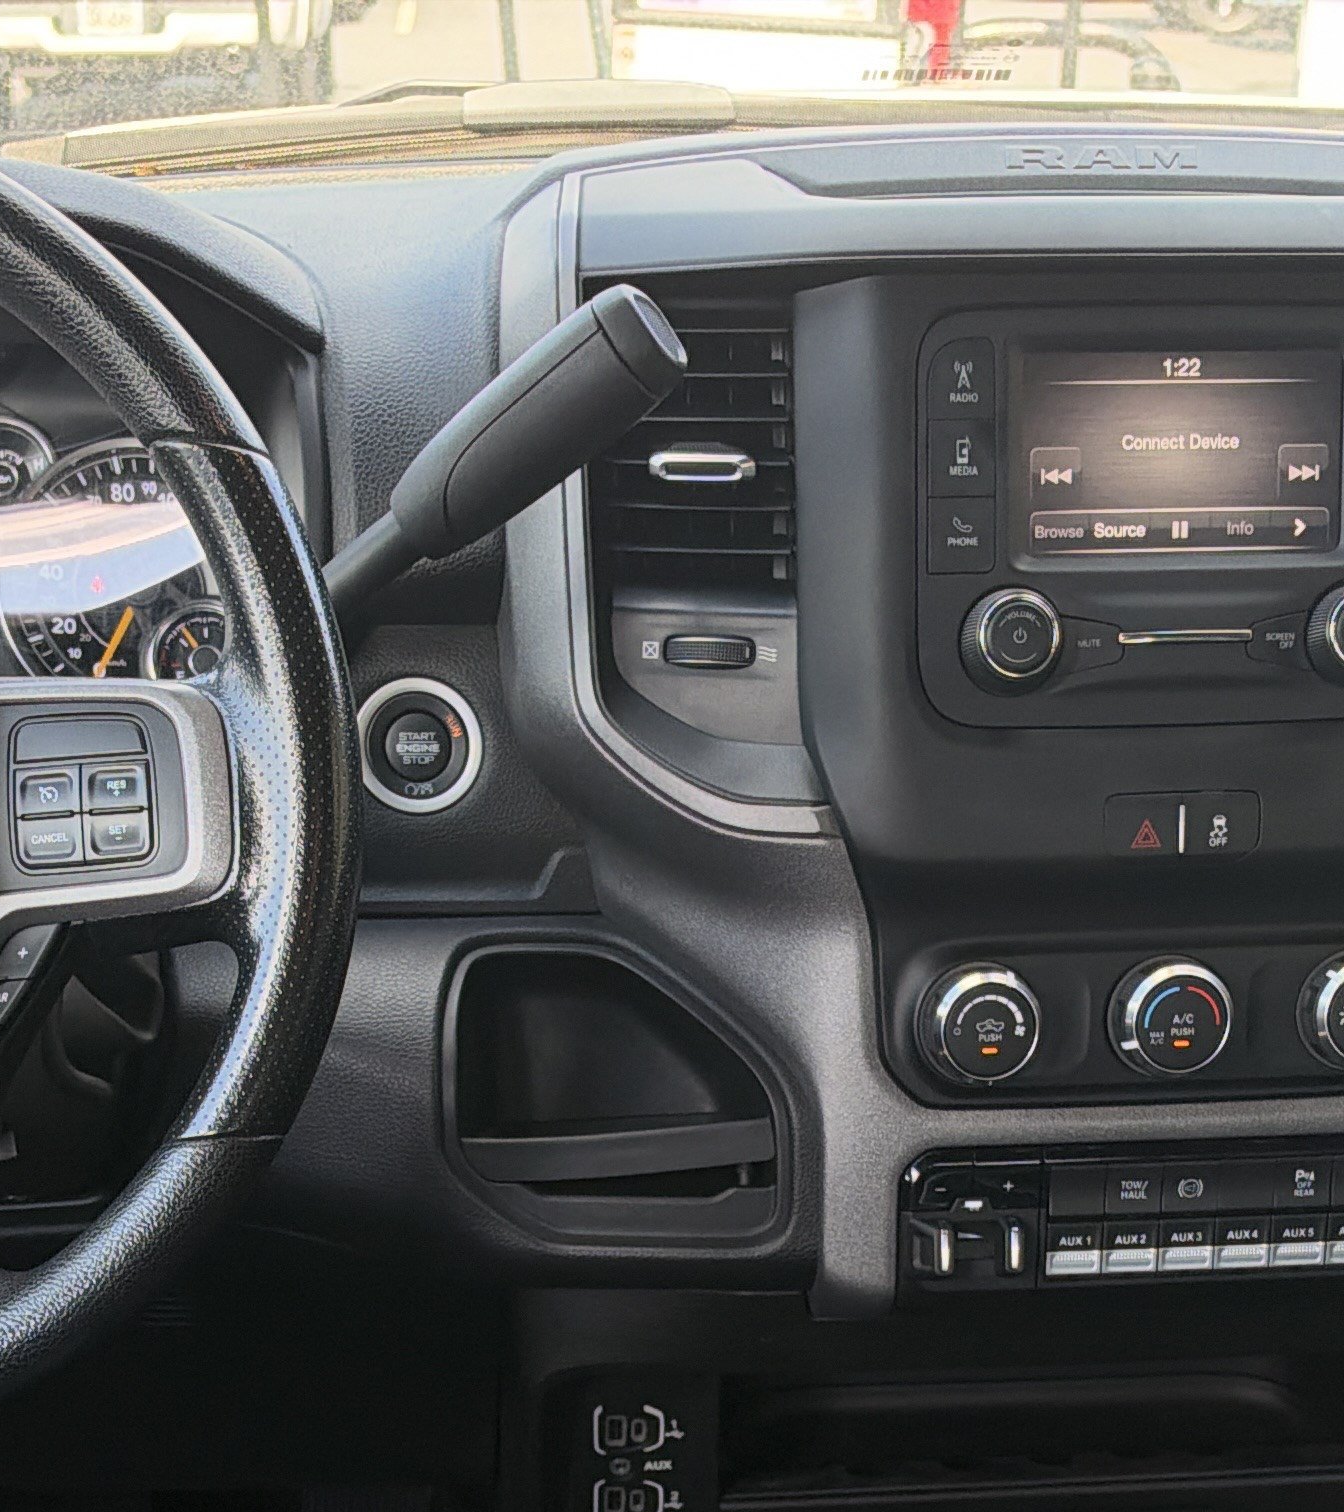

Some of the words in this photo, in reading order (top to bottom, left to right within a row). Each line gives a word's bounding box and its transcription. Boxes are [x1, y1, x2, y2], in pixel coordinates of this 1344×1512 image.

[1006, 145, 1197, 169] RAM
[1163, 358, 1201, 377] 1:22
[949, 393, 979, 403] RADIO
[1121, 434, 1185, 450] Connect
[1189, 433, 1240, 450] Device
[949, 465, 978, 476] MEDIA
[110, 482, 136, 502] 80
[1034, 524, 1084, 539] Browse
[1093, 522, 1147, 538] Source
[1226, 520, 1254, 536] Info
[947, 537, 979, 547] PHONE
[1005, 610, 1036, 620] VOLUME
[51, 617, 77, 635] 20
[1265, 632, 1295, 641] SCREEN
[1077, 639, 1102, 648] MUTE
[1279, 641, 1294, 649] OFF
[66, 647, 82, 659] 10
[399, 732, 436, 741] START
[396, 743, 440, 753] ENGINE
[403, 756, 435, 765] STOP
[107, 780, 126, 790] RES
[108, 825, 127, 835] SET
[31, 832, 69, 845] CANCEL
[1209, 837, 1228, 847] OFF
[1172, 1014, 1195, 1025] A/C
[1171, 1027, 1195, 1037] PUSH
[978, 1033, 1002, 1043] PUSH
[1121, 1180, 1148, 1191] TOW/
[1120, 1190, 1147, 1200] HAUL
[1294, 1189, 1314, 1197] REAR
[1170, 1232, 1194, 1243] AUX
[1196, 1231, 1203, 1242] 3
[1227, 1229, 1251, 1240] AUX
[1252, 1229, 1258, 1239] 4
[1282, 1227, 1306, 1238] AUX
[1307, 1227, 1315, 1237] 5
[1059, 1235, 1083, 1246] AUX
[1086, 1235, 1091, 1245] 1
[1114, 1234, 1138, 1245] AUX
[1140, 1234, 1147, 1244] 2
